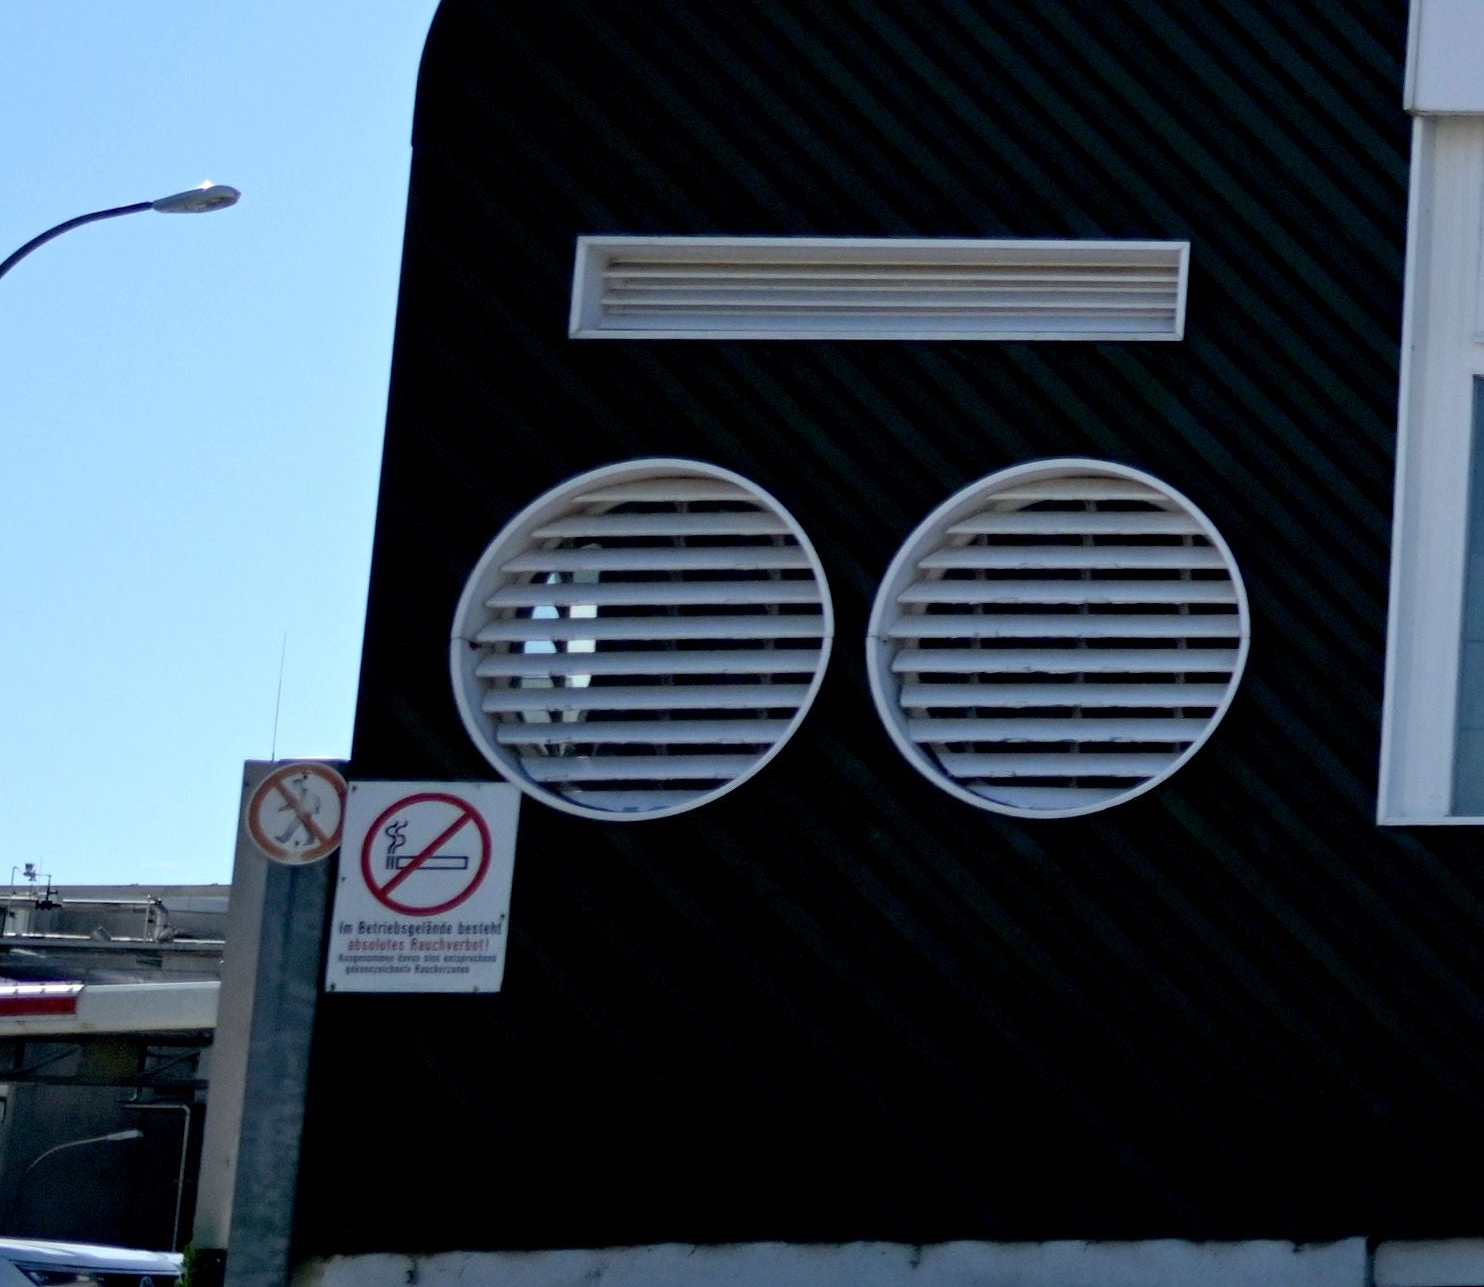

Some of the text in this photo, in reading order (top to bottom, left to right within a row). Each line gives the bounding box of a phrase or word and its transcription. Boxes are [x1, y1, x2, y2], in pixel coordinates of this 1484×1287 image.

[338, 920, 502, 937] Im Betriebsgelände besteht
[348, 937, 490, 952] absolutes Rauchverbot!
